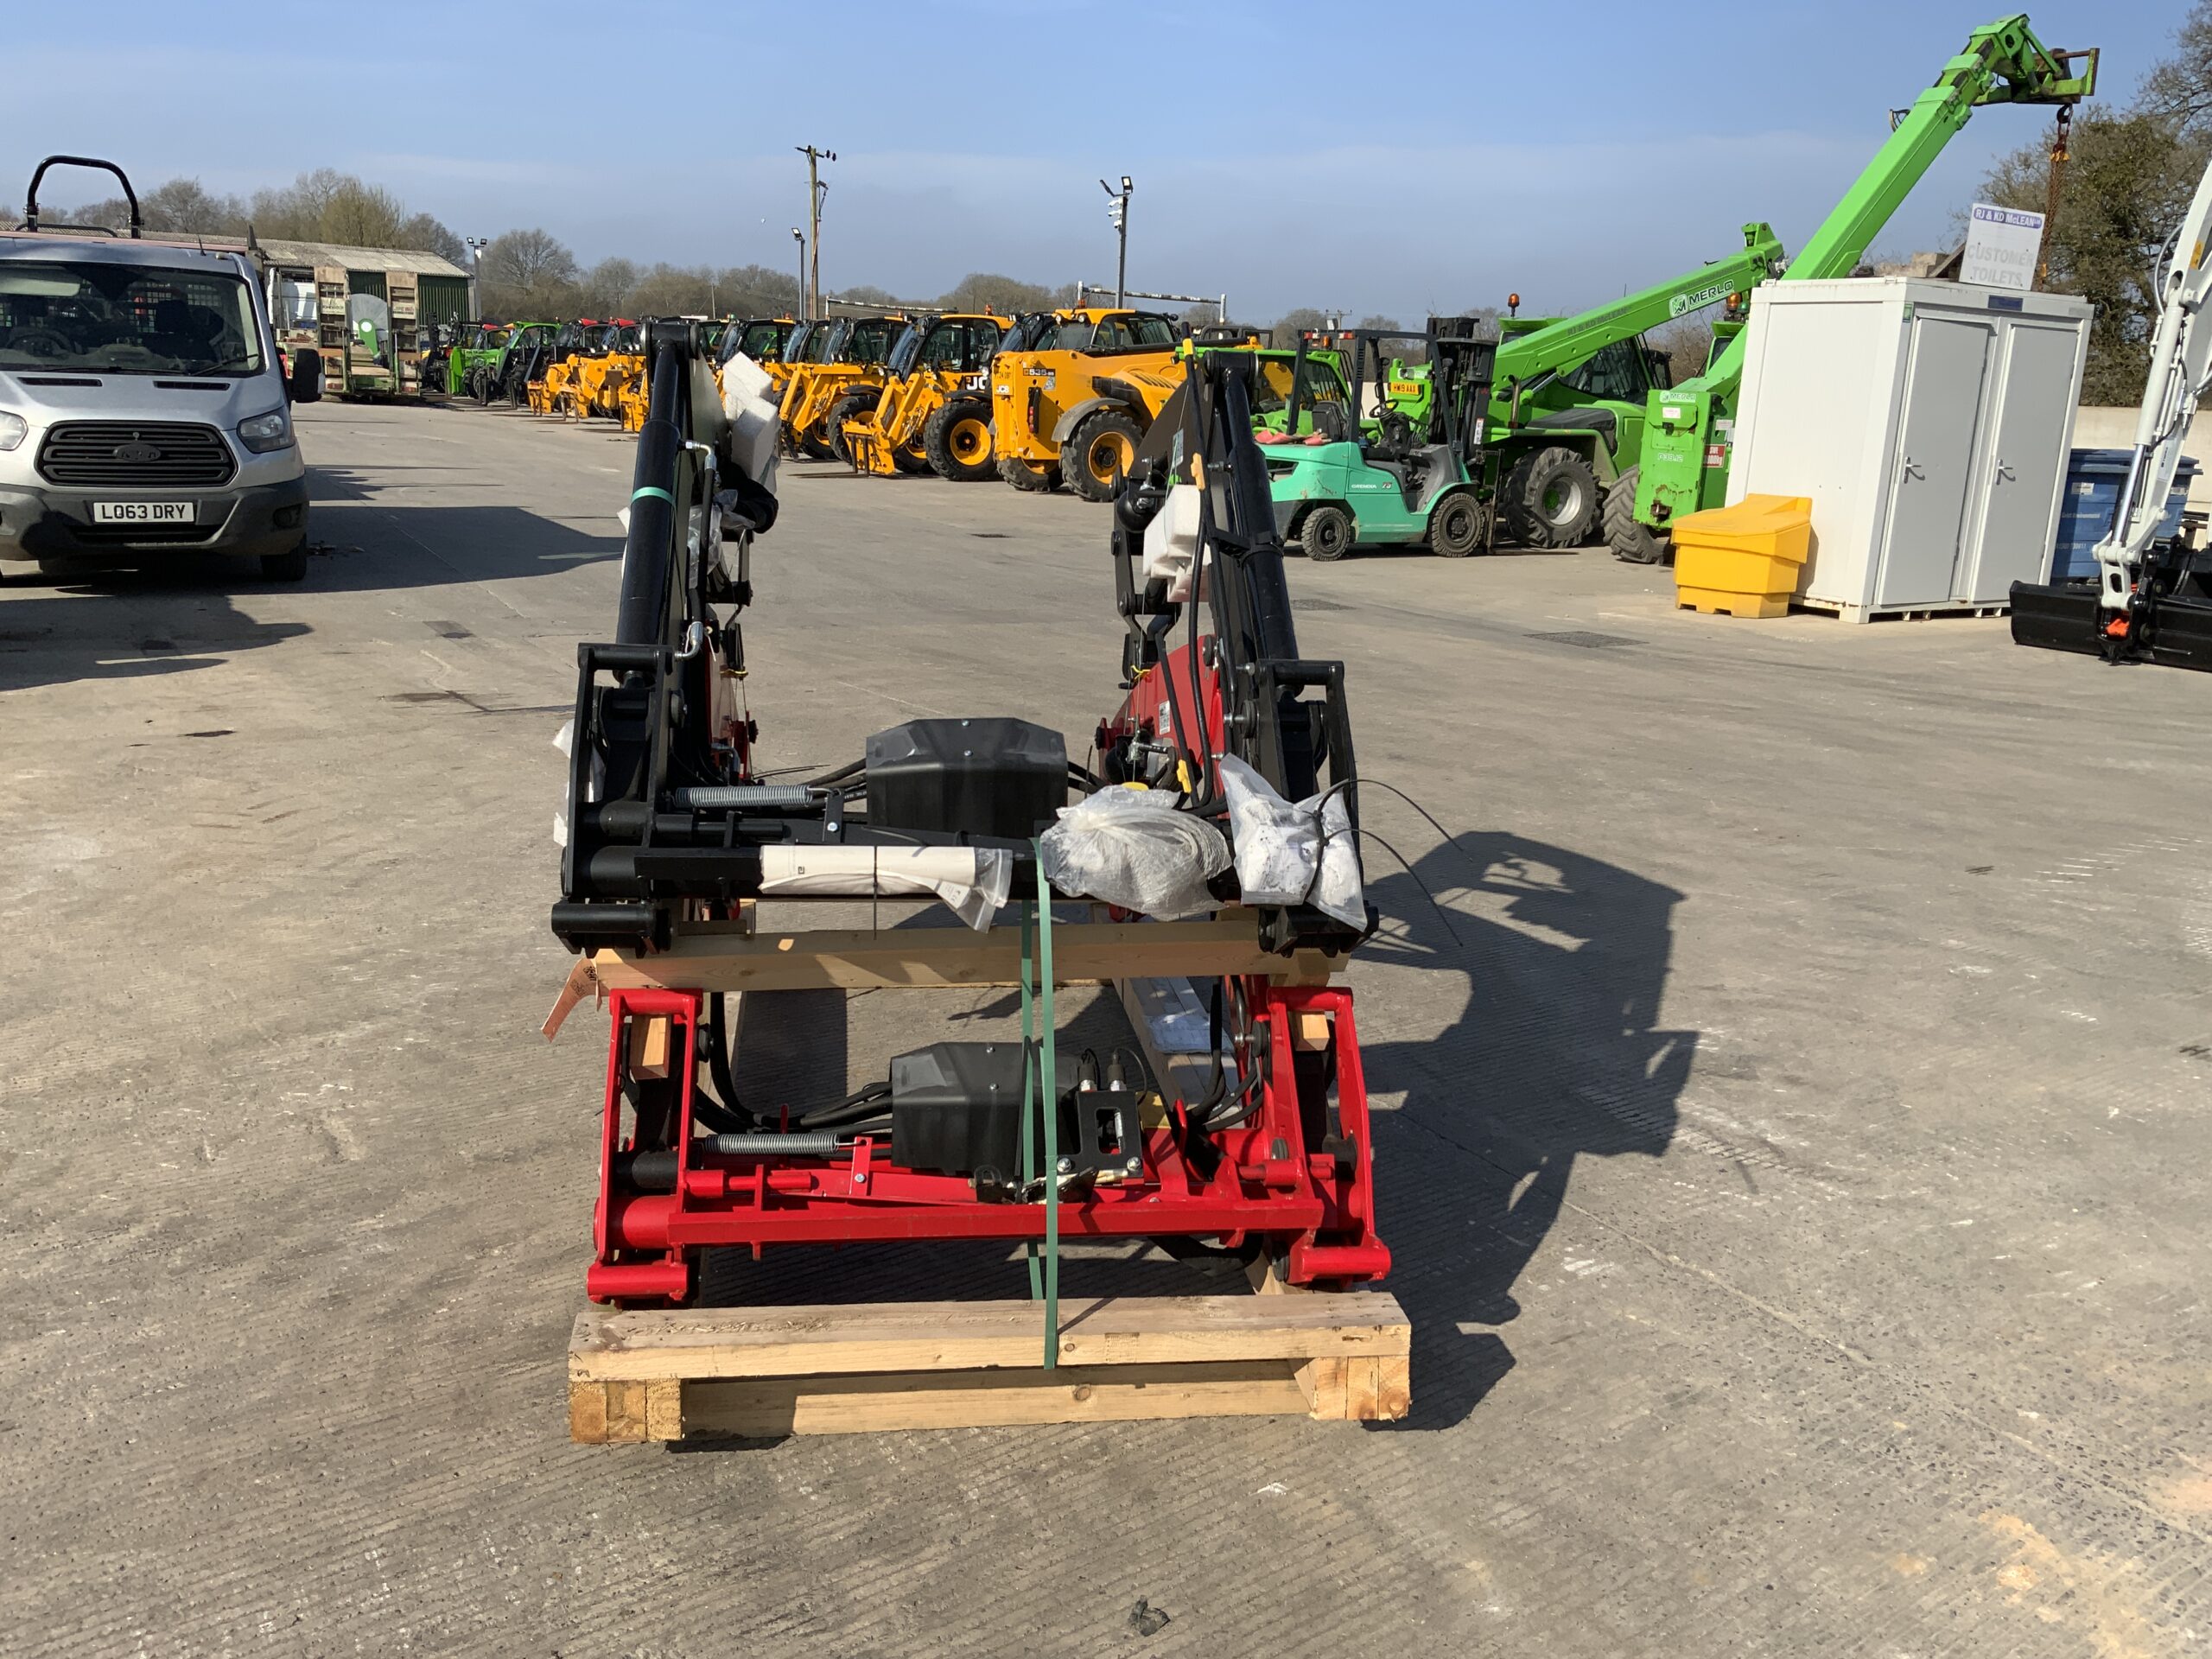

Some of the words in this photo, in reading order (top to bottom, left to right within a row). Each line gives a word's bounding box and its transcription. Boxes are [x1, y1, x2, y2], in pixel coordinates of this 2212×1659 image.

[1975, 208, 1986, 219] RJ
[1986, 210, 1993, 220] &
[1993, 211, 2005, 222] KD
[2005, 213, 2035, 227] McLEAN
[1967, 245, 2034, 267] CUSTOMER
[1973, 266, 2023, 285] TOILETS
[1688, 278, 1735, 307] MERLO
[966, 376, 988, 391] JC
[995, 385, 1009, 394] JCB
[1670, 392, 1696, 401] MERLO
[152, 505, 186, 519] DRY
